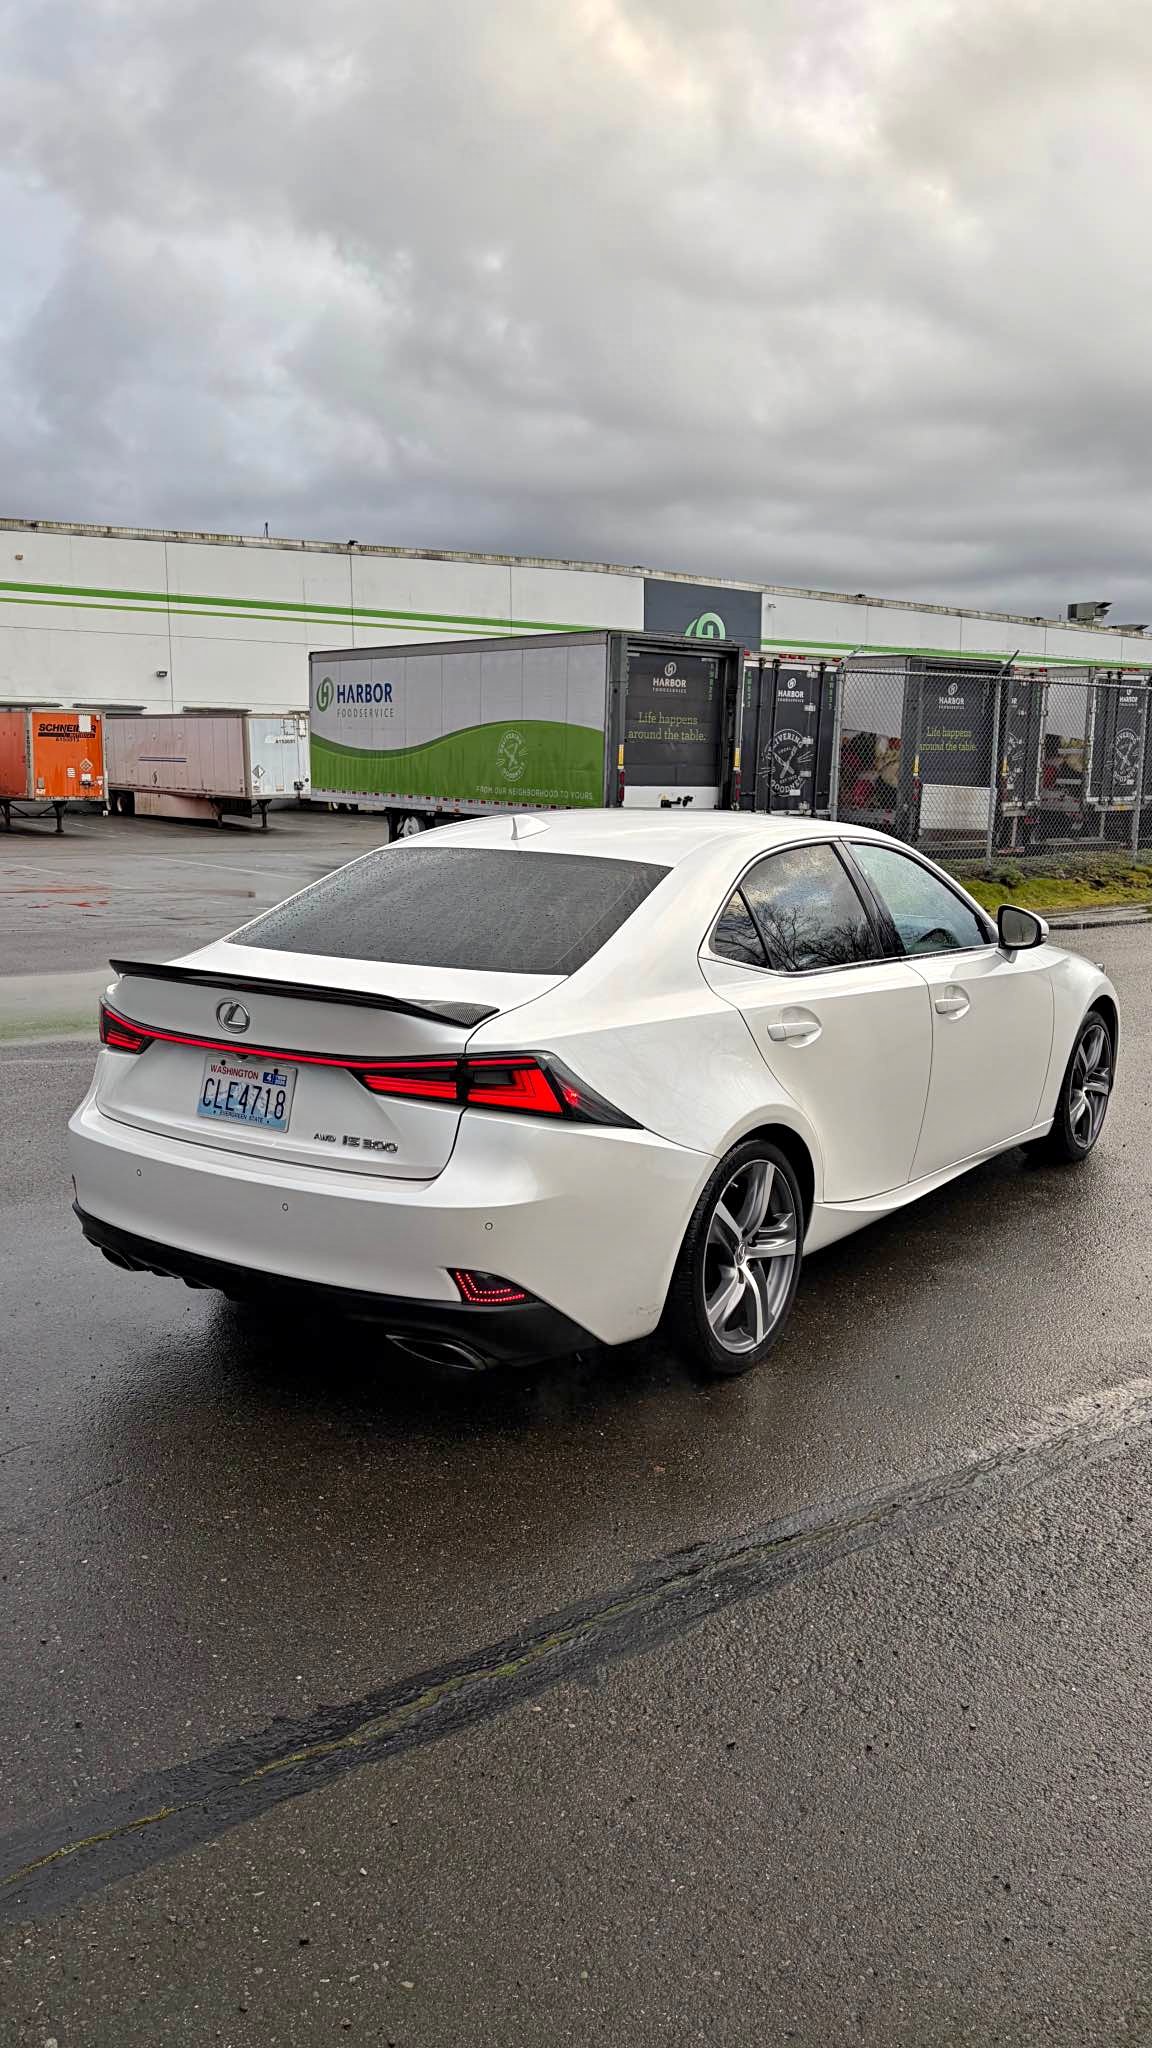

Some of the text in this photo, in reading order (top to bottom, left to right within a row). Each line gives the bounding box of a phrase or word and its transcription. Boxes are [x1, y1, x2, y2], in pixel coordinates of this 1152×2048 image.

[653, 677, 687, 688] HARBOR
[337, 683, 393, 704] HARBOR
[777, 689, 804, 699] HARBOR
[939, 696, 965, 705] HARBOR
[336, 708, 395, 719] FOODSERVICE
[638, 711, 699, 727] Life happens
[38, 723, 97, 734] SCHNEIR
[627, 728, 707, 742] around the table.
[476, 785, 593, 800] FROM OUR NEIGHBORHOOD TO YOURS
[210, 1064, 259, 1080] WASHINGTON
[202, 1077, 286, 1120] CLE4718
[313, 1133, 399, 1154] AWD IS 300
